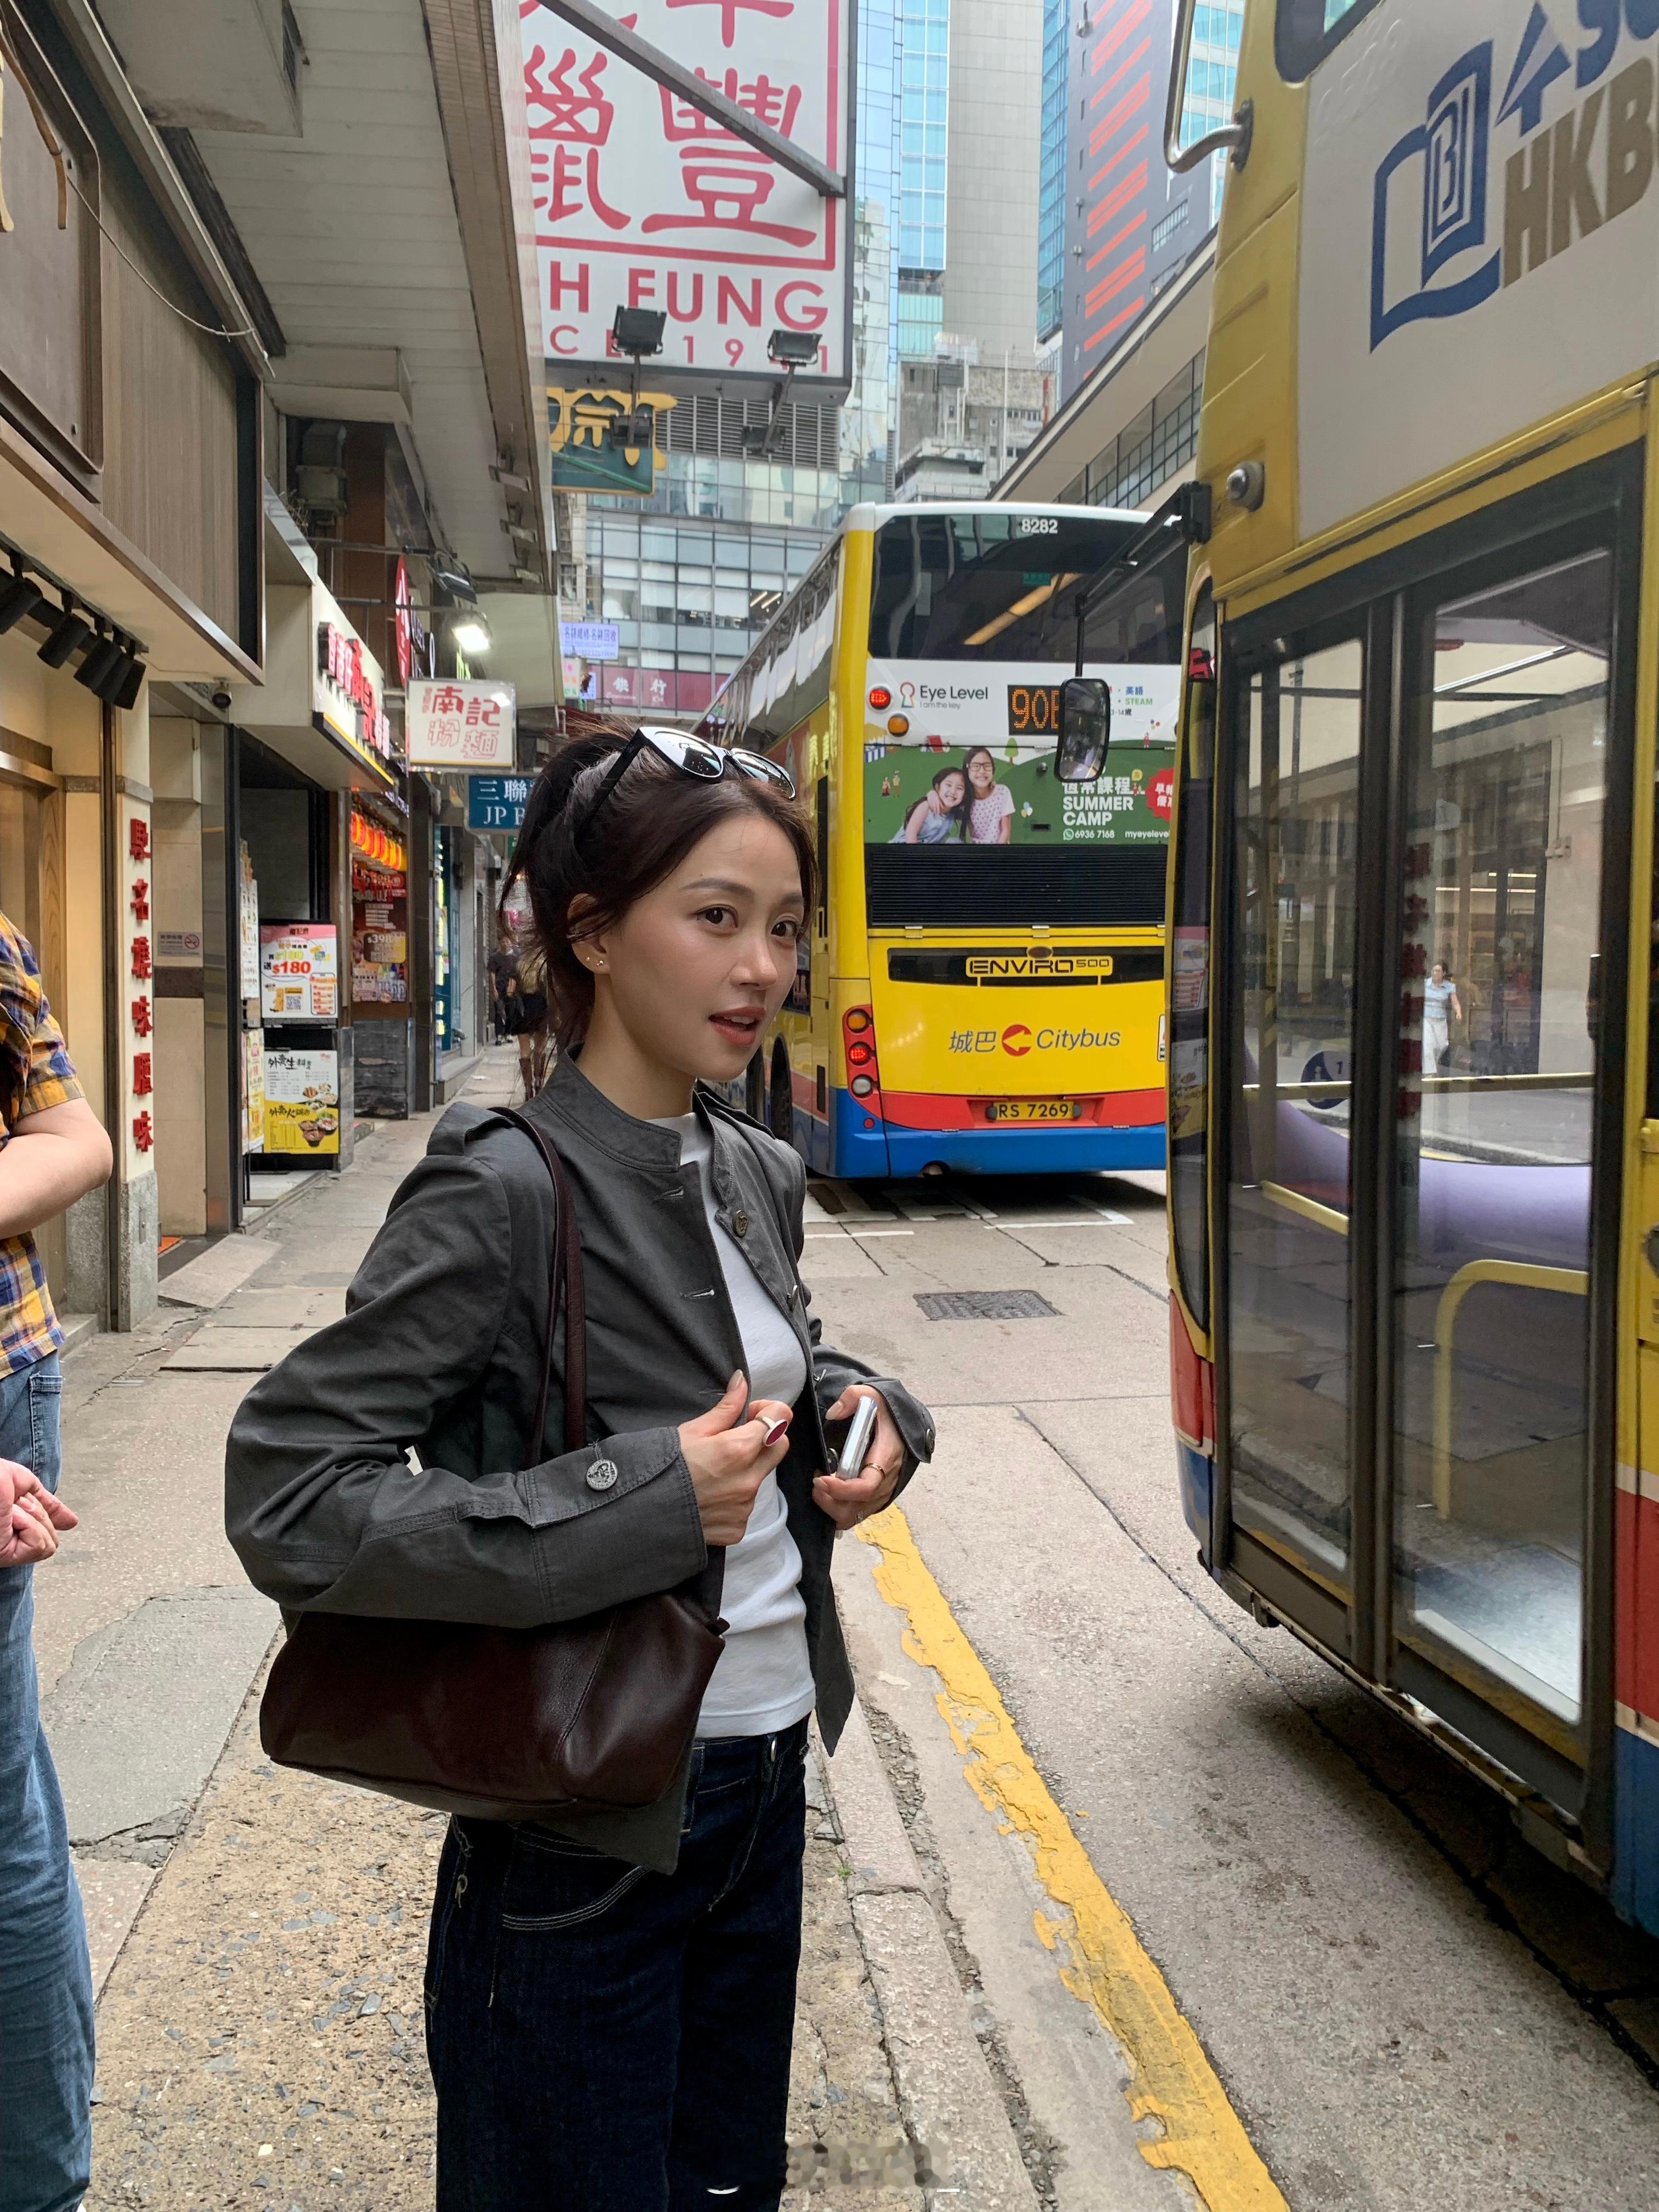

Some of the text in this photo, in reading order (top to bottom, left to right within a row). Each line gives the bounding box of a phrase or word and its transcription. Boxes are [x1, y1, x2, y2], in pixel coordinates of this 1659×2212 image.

[1504, 57, 1659, 289] HKB
[628, 267, 828, 332] FUNG
[682, 335, 828, 375] 191
[1022, 518, 1058, 534] 8282
[920, 685, 988, 701] Eye Level
[1125, 686, 1143, 696] 英語
[432, 686, 501, 727] 南記
[949, 701, 961, 710] key
[427, 718, 499, 760] 粉麵
[477, 779, 536, 803] 三聯
[1063, 796, 1134, 811] SUMMER
[483, 806, 507, 825] JP
[1063, 811, 1113, 826] CAMP
[1075, 829, 1095, 839] 6936
[1097, 829, 1115, 839] 7168
[272, 961, 312, 974] $180
[969, 959, 1109, 974] ENVIRO 500
[949, 1030, 997, 1053] 城巴
[1036, 1028, 1121, 1051] Citybus
[998, 1103, 1069, 1118] RS 7269
